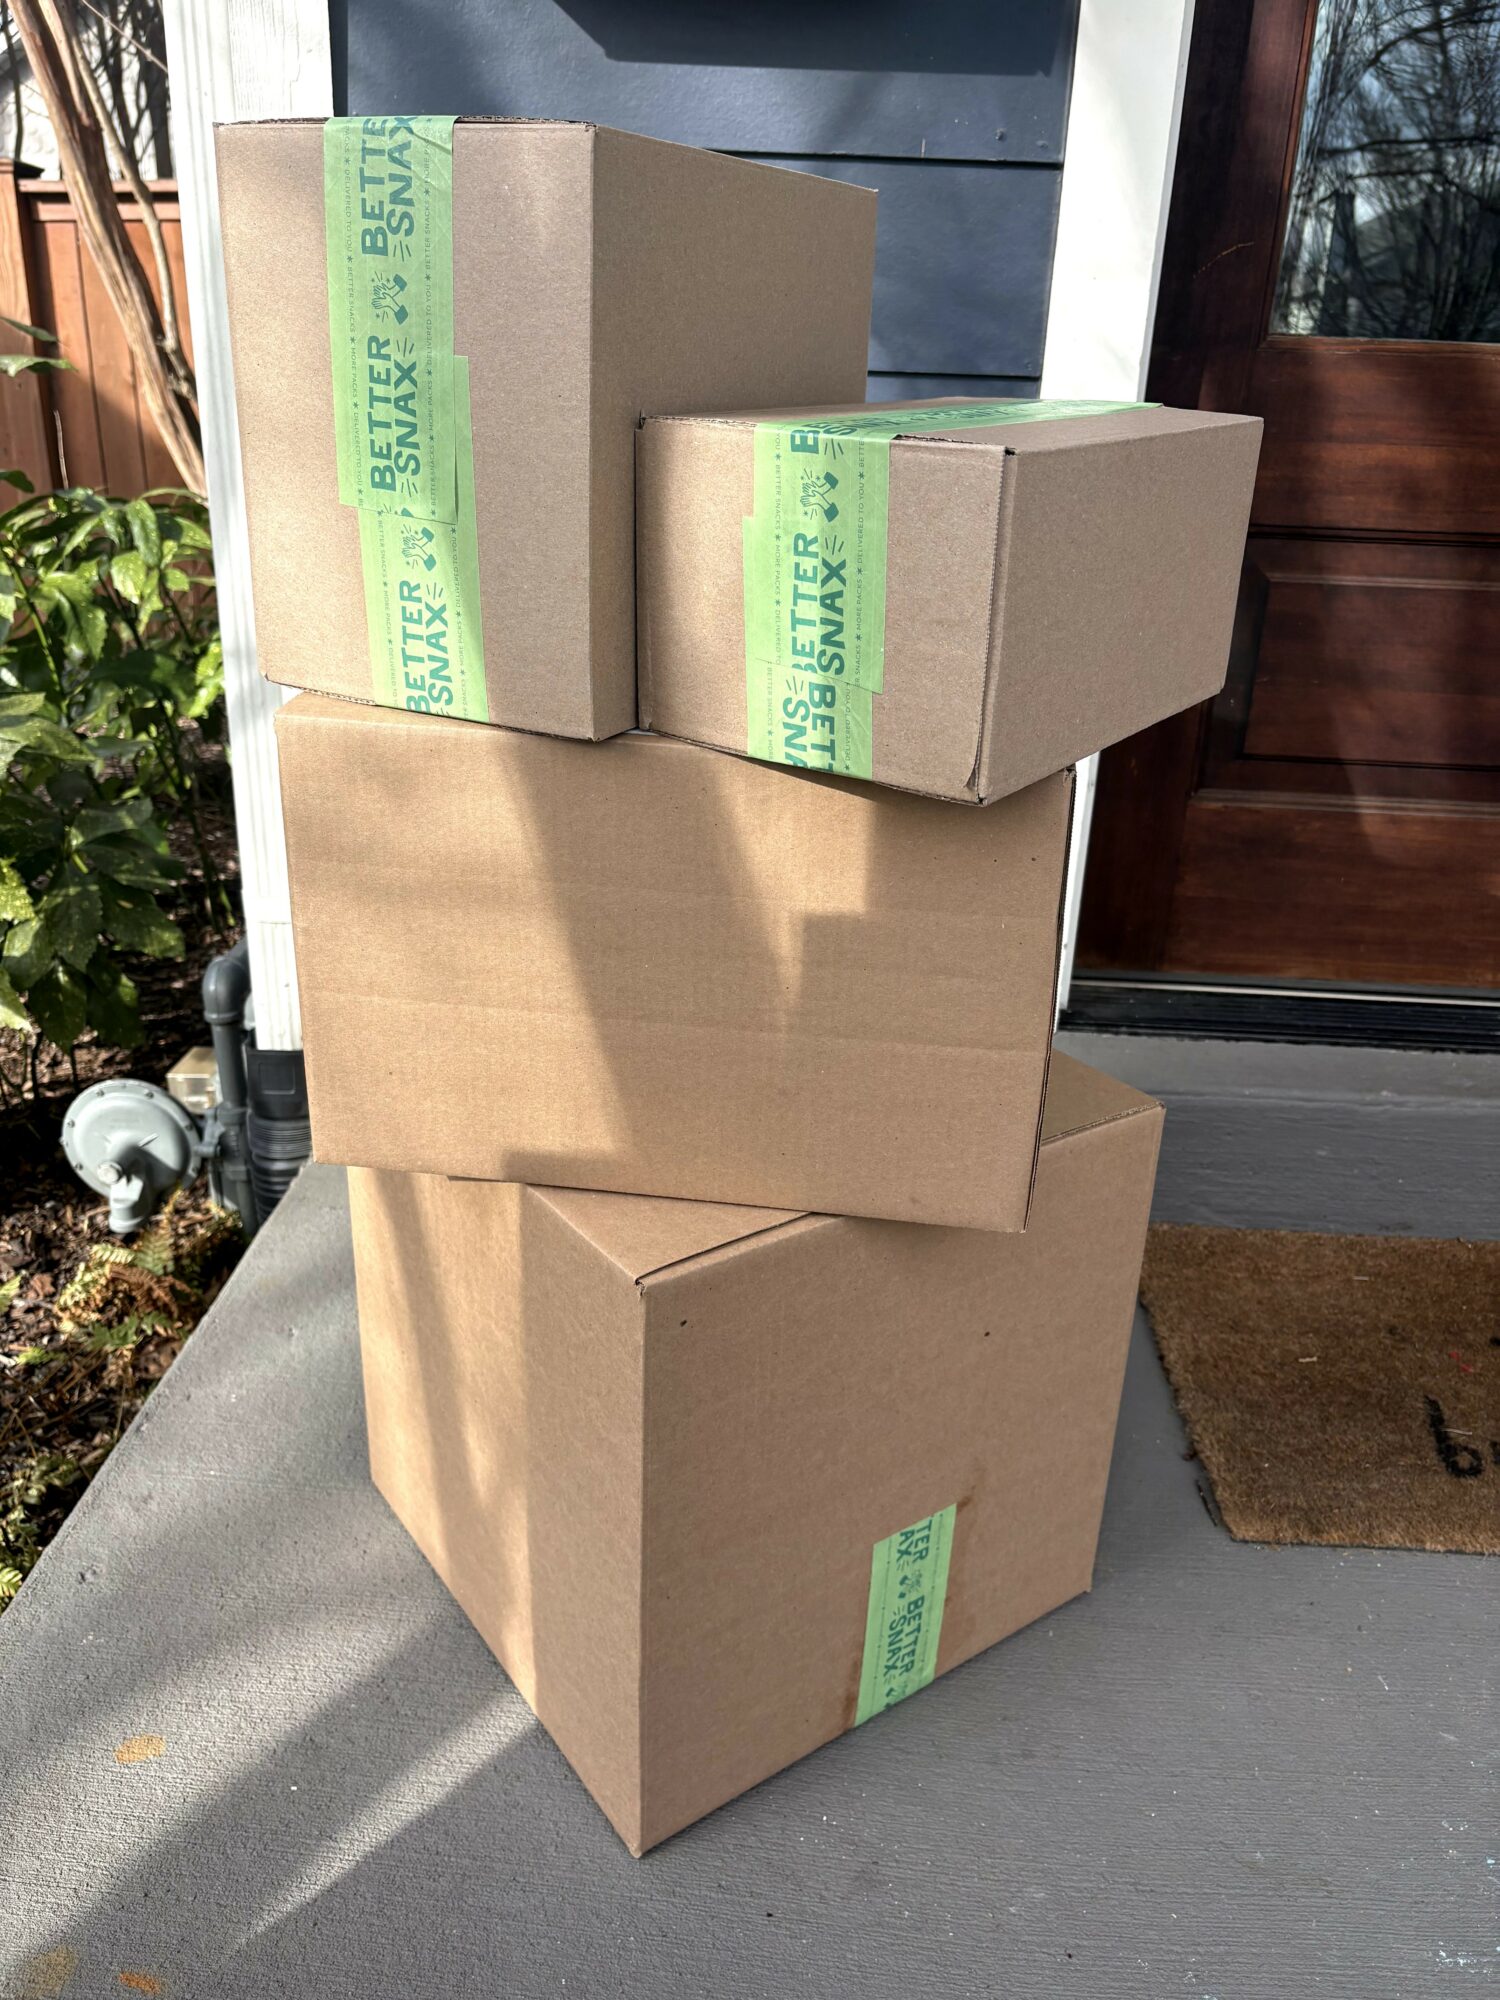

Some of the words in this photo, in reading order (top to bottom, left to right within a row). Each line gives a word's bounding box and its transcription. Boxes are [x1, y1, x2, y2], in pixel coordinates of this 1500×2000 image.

[386, 117, 417, 237] SNAX
[367, 335, 396, 492] BETTER
[393, 359, 421, 476] SNAX
[399, 580, 431, 713] BETTER
[424, 601, 454, 706] SNAX
[816, 557, 847, 675] SNAX
[883, 1614, 908, 1677] SNAX
[899, 1594, 925, 1675] BETTER
